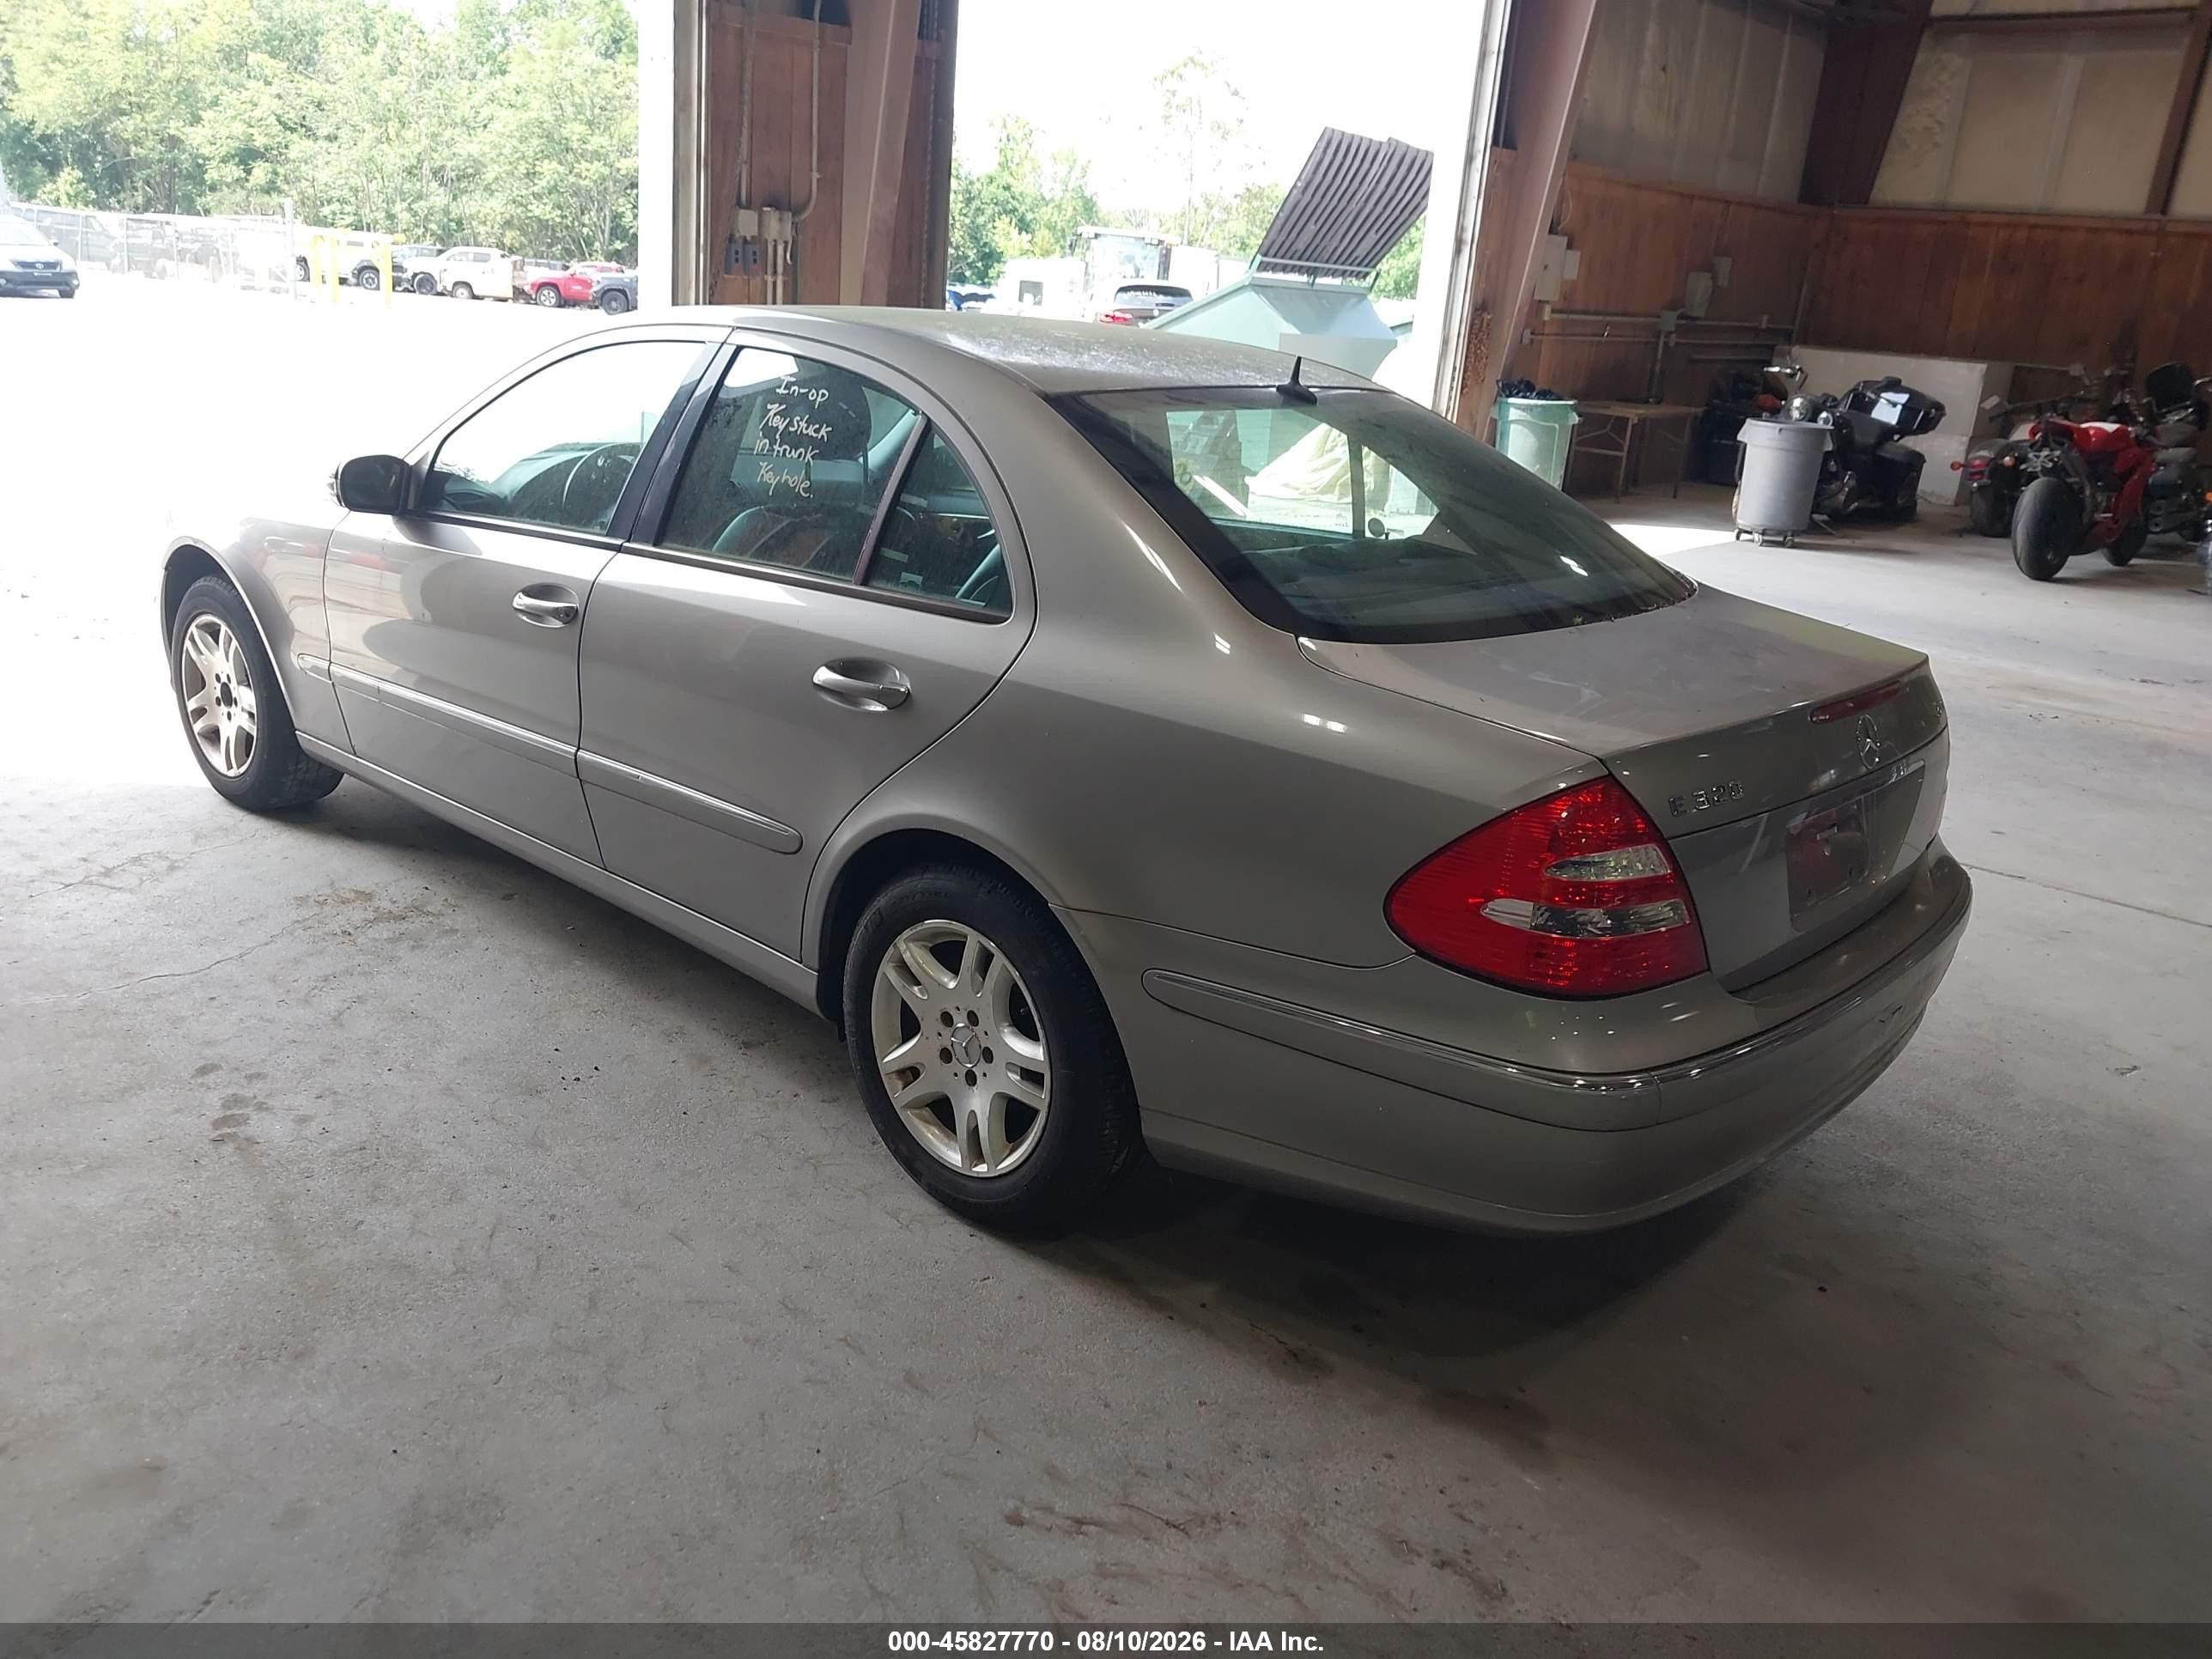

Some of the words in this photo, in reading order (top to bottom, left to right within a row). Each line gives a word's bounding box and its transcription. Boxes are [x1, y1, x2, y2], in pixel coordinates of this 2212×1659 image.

[776, 376, 829, 409] In-op
[760, 404, 791, 439] Key
[788, 415, 833, 442] stuck
[754, 431, 769, 455] in
[773, 439, 820, 467] trunk
[1668, 797, 1689, 817] E
